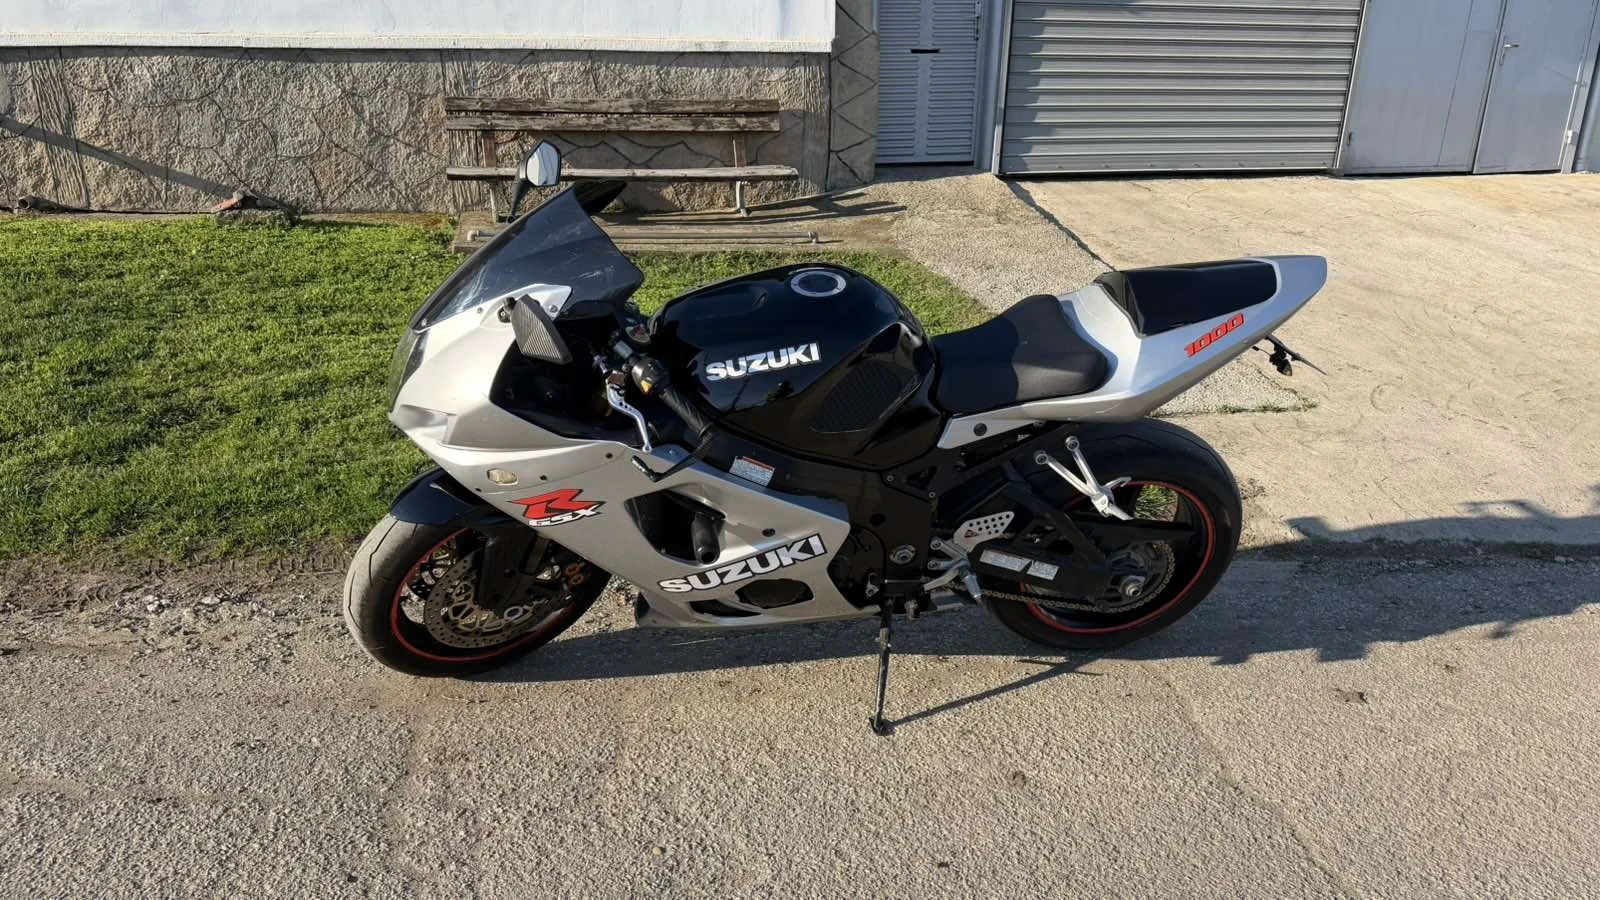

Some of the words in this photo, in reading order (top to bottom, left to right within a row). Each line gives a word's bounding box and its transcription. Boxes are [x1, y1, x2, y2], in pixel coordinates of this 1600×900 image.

[1184, 313, 1244, 357] 1000
[706, 342, 820, 381] SUZUKI
[510, 489, 606, 519] R
[528, 504, 602, 527] GSX
[659, 534, 827, 593] SUZUKI
